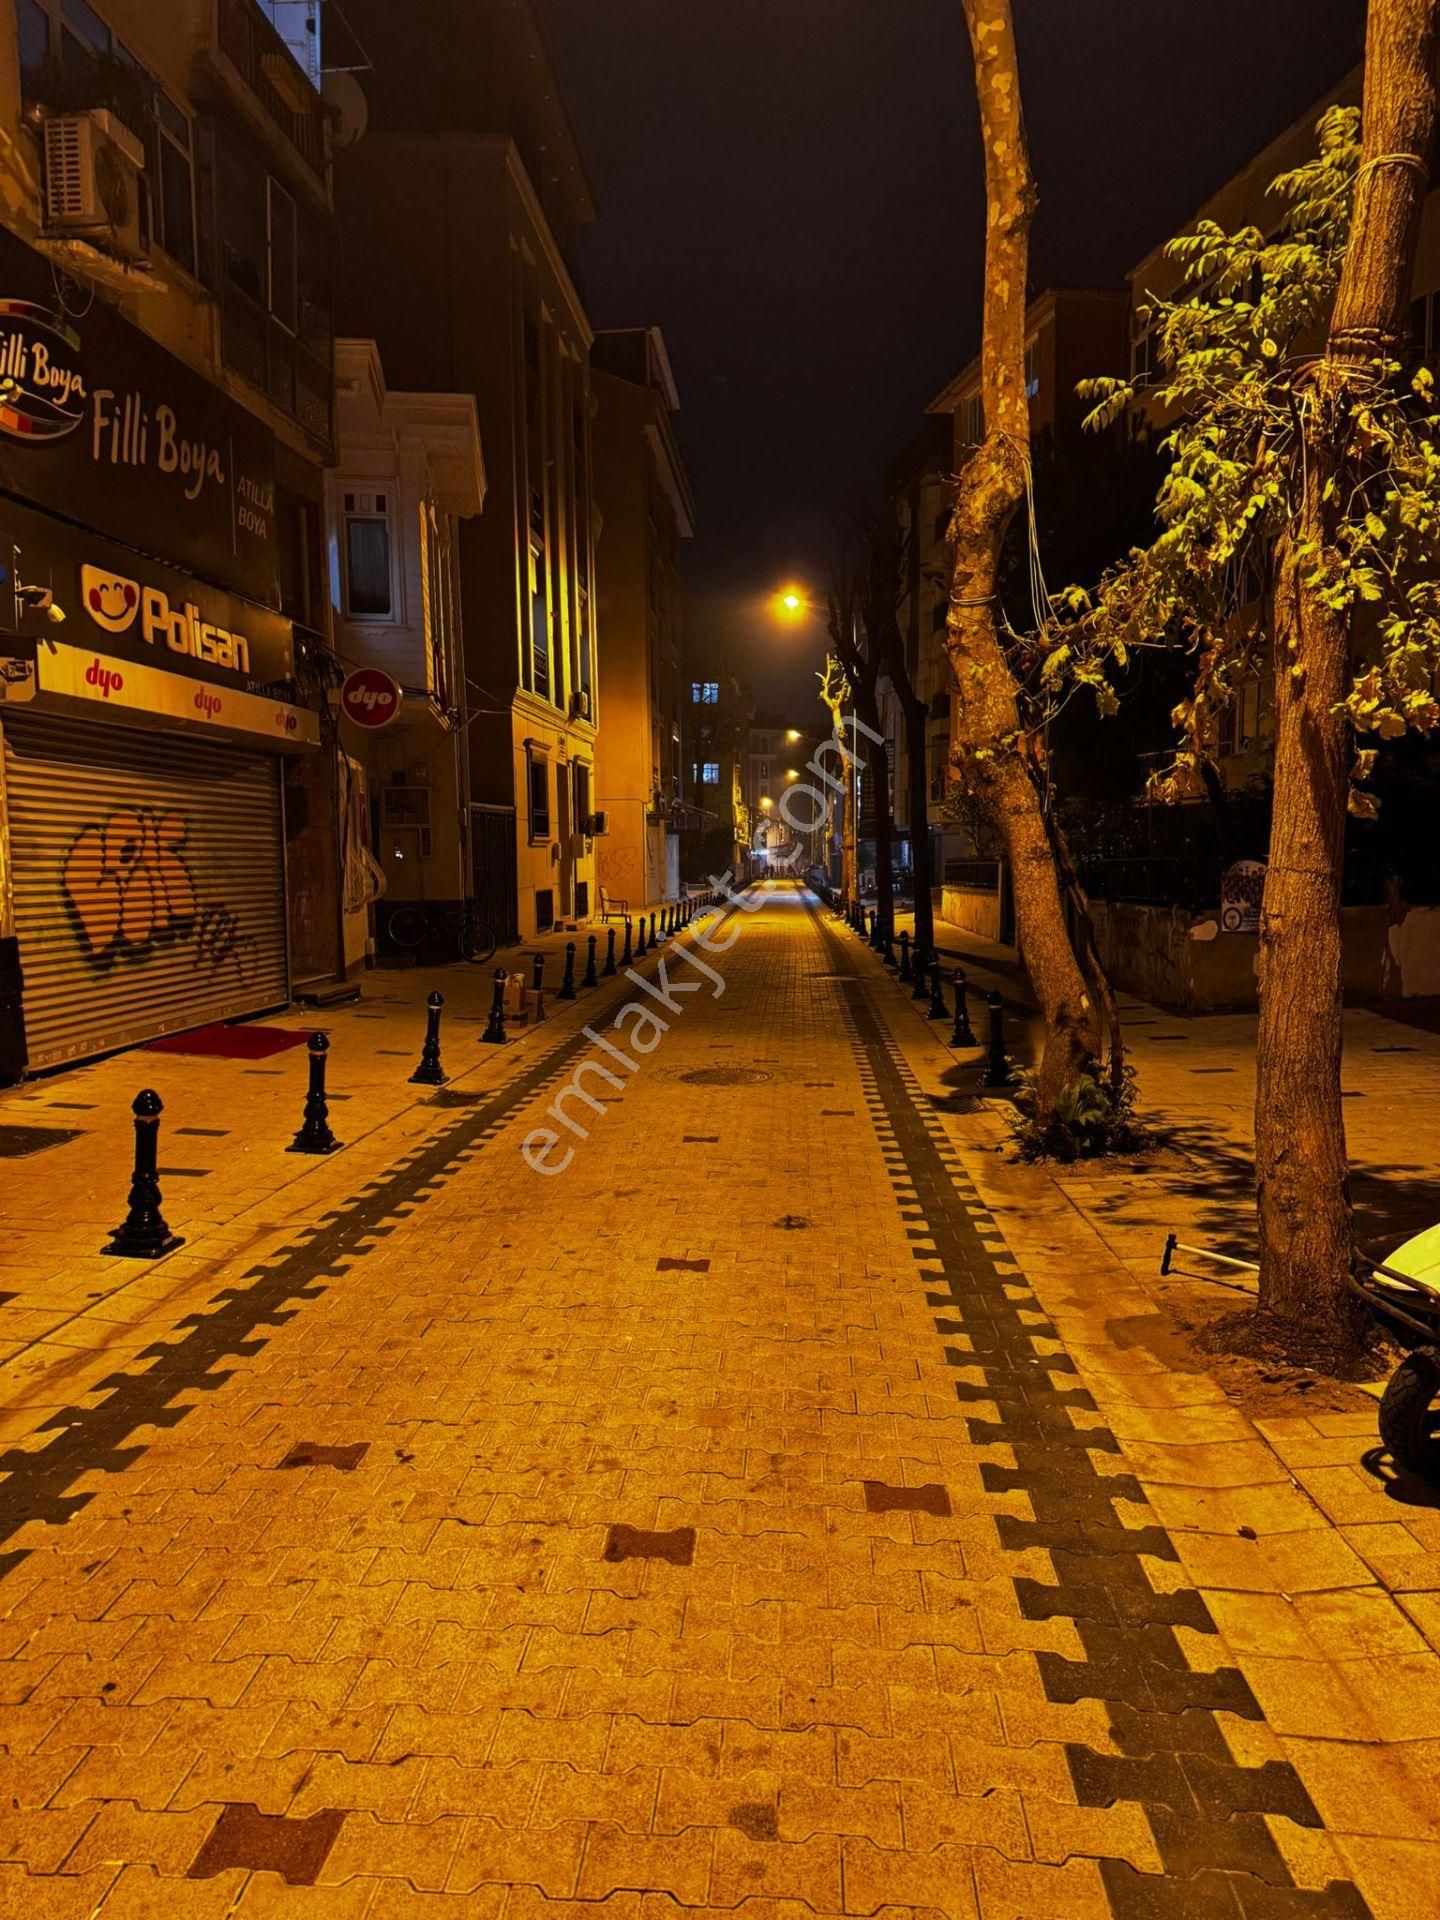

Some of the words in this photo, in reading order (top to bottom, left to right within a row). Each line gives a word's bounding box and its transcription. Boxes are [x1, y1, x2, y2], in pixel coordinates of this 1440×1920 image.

[0, 330, 28, 380] illi
[31, 341, 87, 405] Boya
[93, 389, 149, 466] Filli
[155, 404, 225, 500] Boya
[238, 505, 267, 540] BOYA
[142, 586, 251, 674] Polisan
[85, 659, 124, 697] dyo
[194, 686, 222, 719] dyo
[347, 684, 393, 711] dyo
